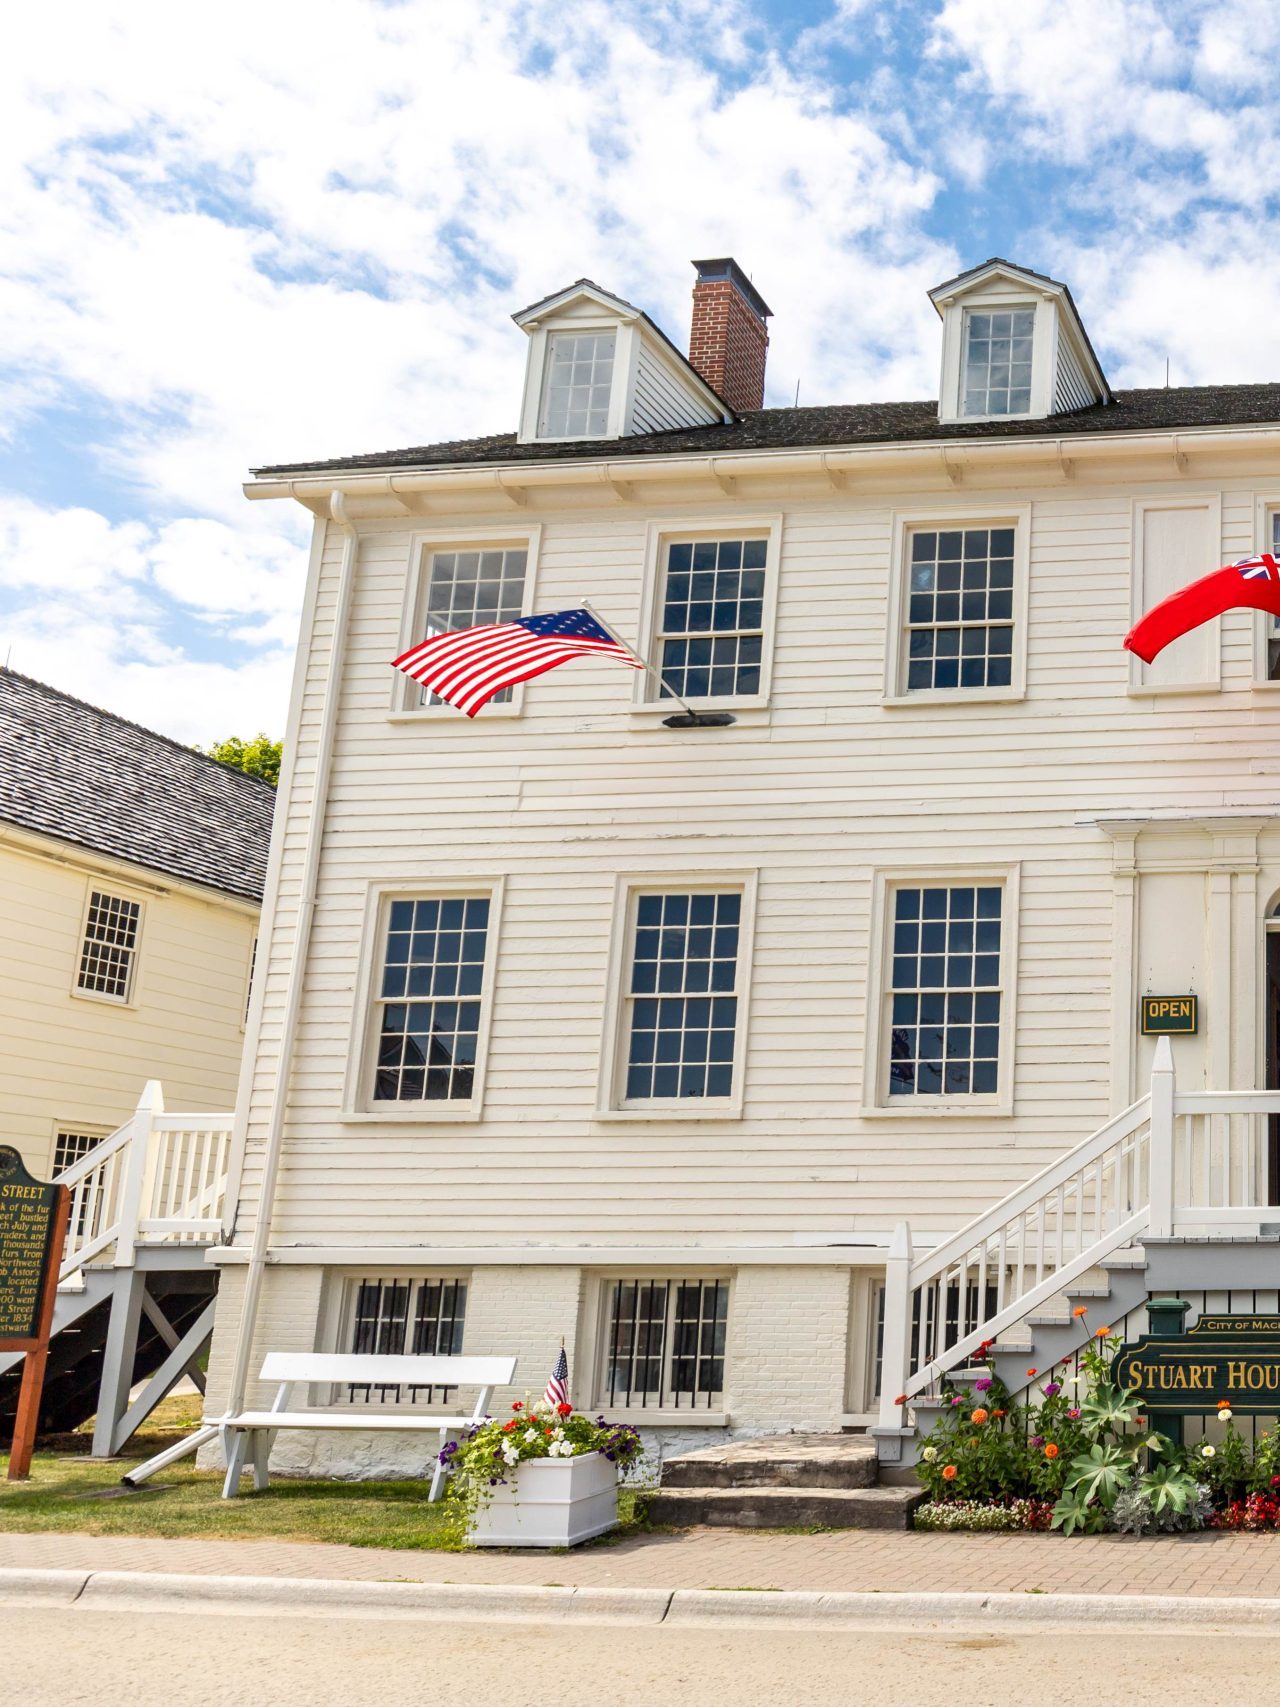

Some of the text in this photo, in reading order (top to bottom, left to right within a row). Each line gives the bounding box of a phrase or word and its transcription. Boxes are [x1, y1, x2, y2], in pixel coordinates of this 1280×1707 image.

[1149, 1001, 1190, 1018] OPEN
[1, 1184, 46, 1200] STREET
[9, 1203, 19, 1212] of
[21, 1203, 33, 1213] the
[37, 1204, 50, 1214] fur
[20, 1212, 49, 1222] bustled
[11, 1221, 30, 1232] July
[31, 1223, 48, 1232] and
[30, 1232, 46, 1241] and
[3, 1240, 45, 1250] thousands
[1, 1249, 43, 1259] furs from
[8, 1276, 39, 1286] located
[20, 1285, 37, 1295] Furs
[16, 1296, 36, 1304] went
[8, 1304, 35, 1314] Street
[13, 1313, 33, 1323] 1834
[1207, 1321, 1232, 1330] CITY
[1128, 1361, 1217, 1390] STUART
